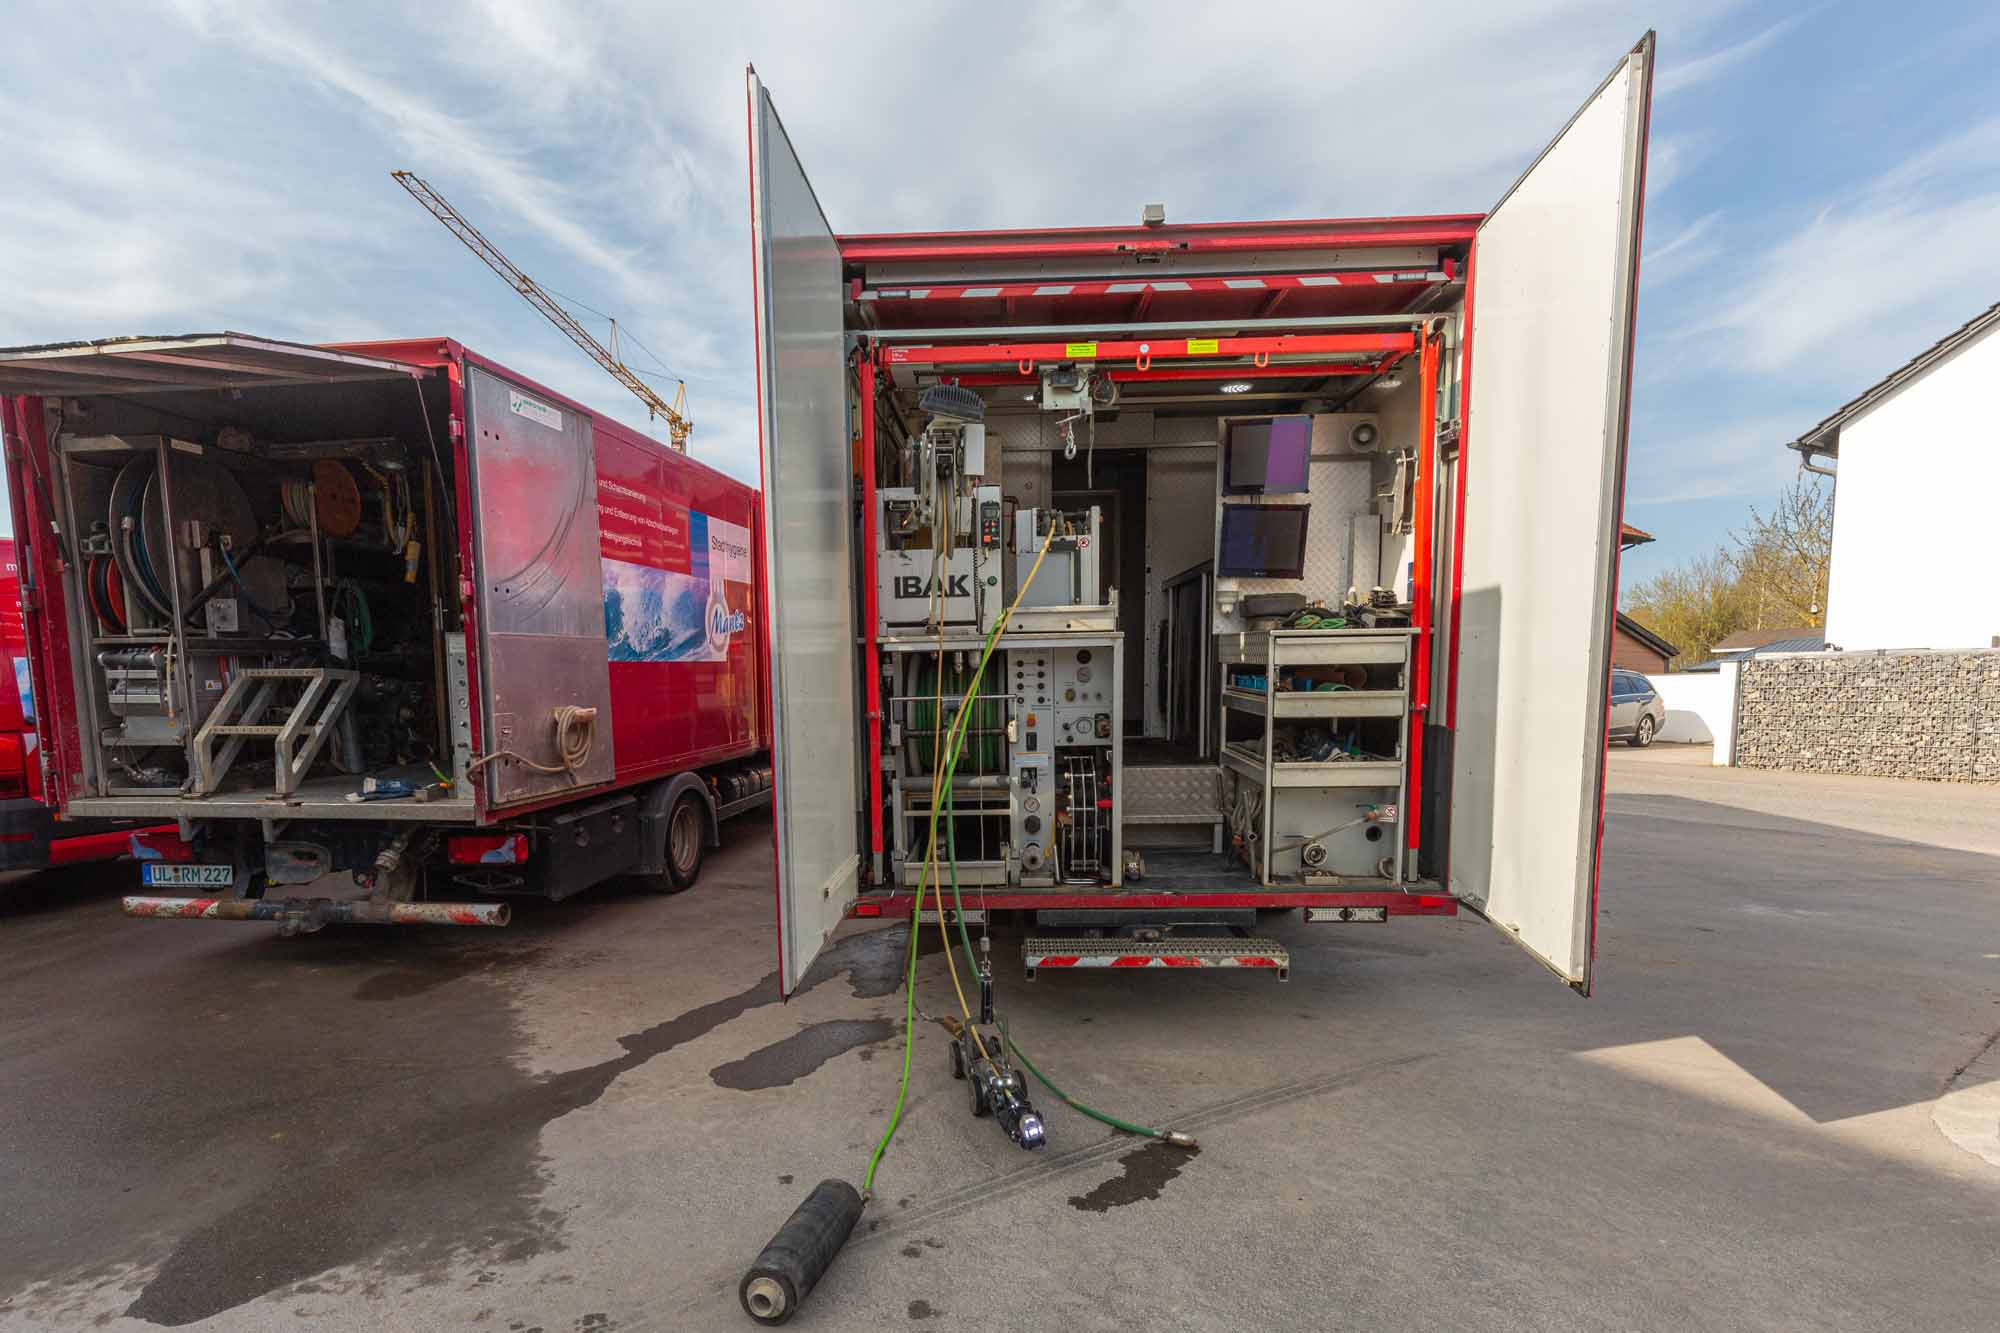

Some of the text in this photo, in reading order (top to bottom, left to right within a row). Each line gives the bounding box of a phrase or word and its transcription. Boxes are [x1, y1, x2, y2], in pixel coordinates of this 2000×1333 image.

[894, 574, 970, 599] IBAK
[152, 866, 231, 882] UL RM 227
